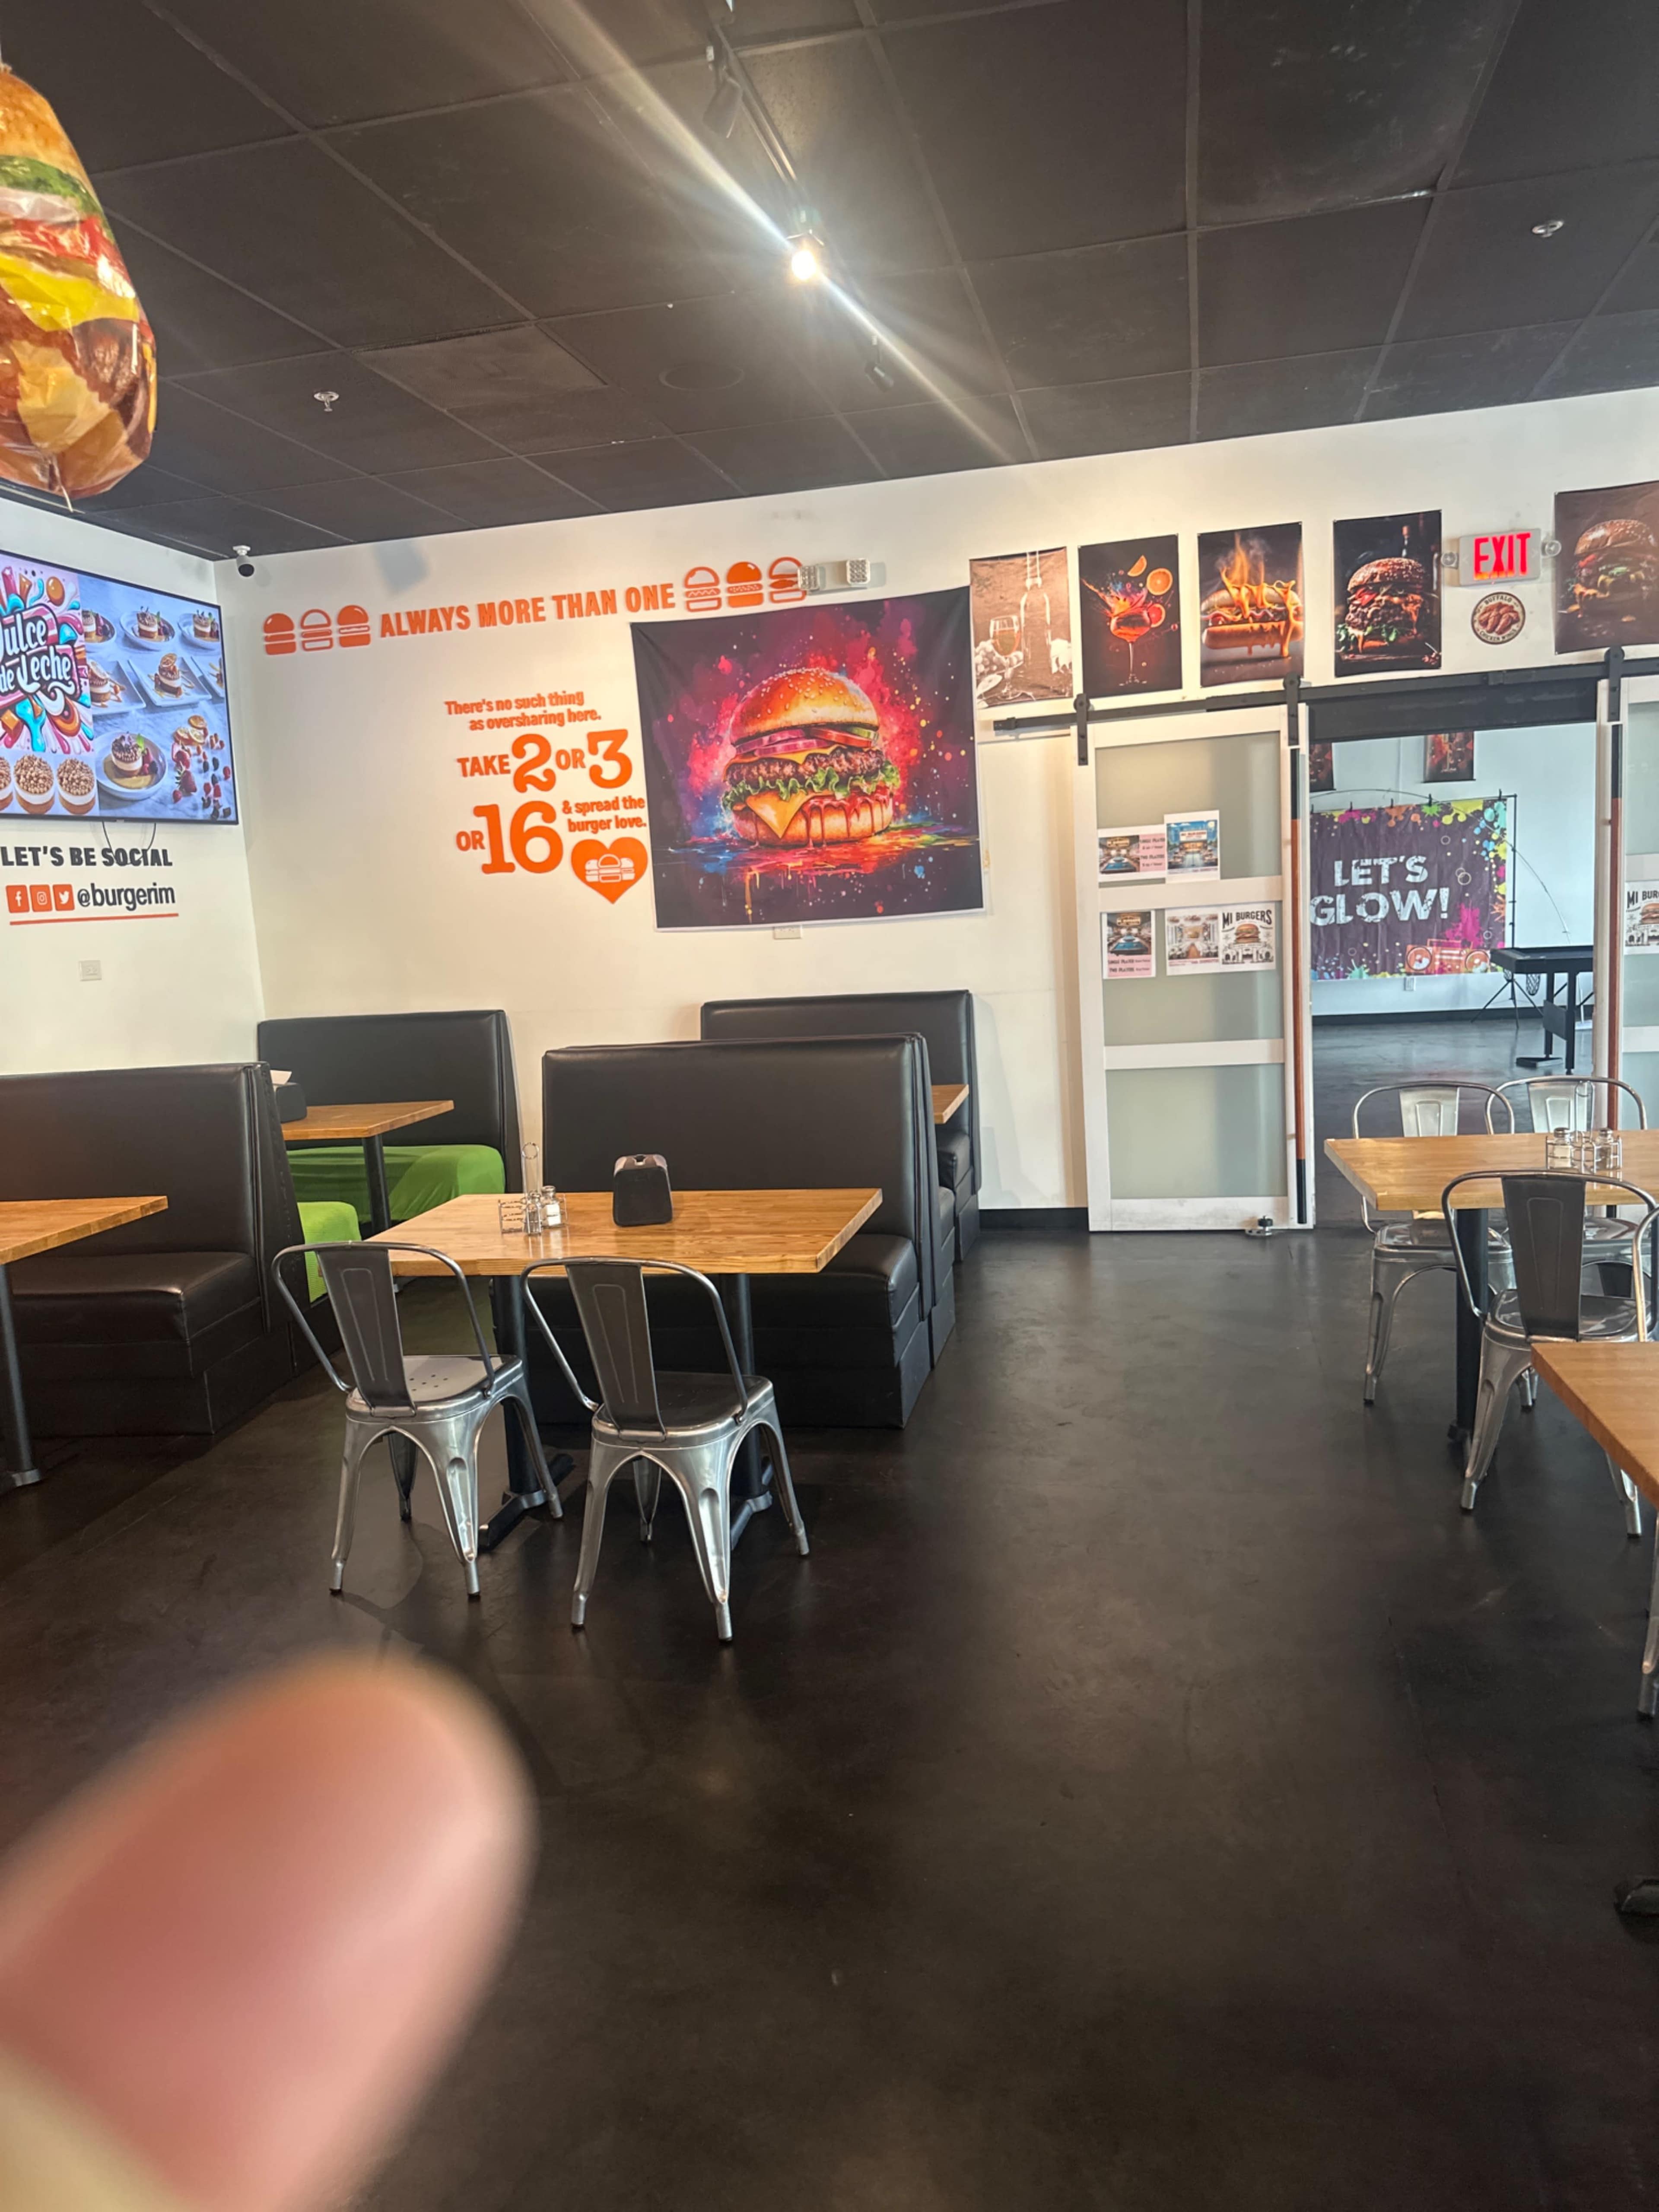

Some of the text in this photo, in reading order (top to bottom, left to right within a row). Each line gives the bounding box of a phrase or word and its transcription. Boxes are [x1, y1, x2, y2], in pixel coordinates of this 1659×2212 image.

[1474, 532, 1531, 581] EXIT
[380, 583, 675, 638] ALWAYS MORE THAN ONE
[1484, 594, 1513, 604] BUFFALO
[0, 613, 46, 662] ulce
[16, 645, 71, 693] Leche
[445, 690, 584, 715] There's no such thing
[469, 708, 602, 731] as oversharing here.
[457, 729, 633, 793] TAKE 2 OR 3
[562, 796, 645, 817] & spread the
[456, 801, 564, 874] OR 16
[568, 815, 647, 834] burger love.
[0, 846, 173, 866] LET'S BE SOCIAL
[1334, 856, 1428, 886] LET'S
[77, 883, 175, 911] @burgerim
[1310, 887, 1449, 926] GLOW!
[1627, 890, 1659, 909] MI BUR
[1222, 909, 1272, 928] MI BURGERS
